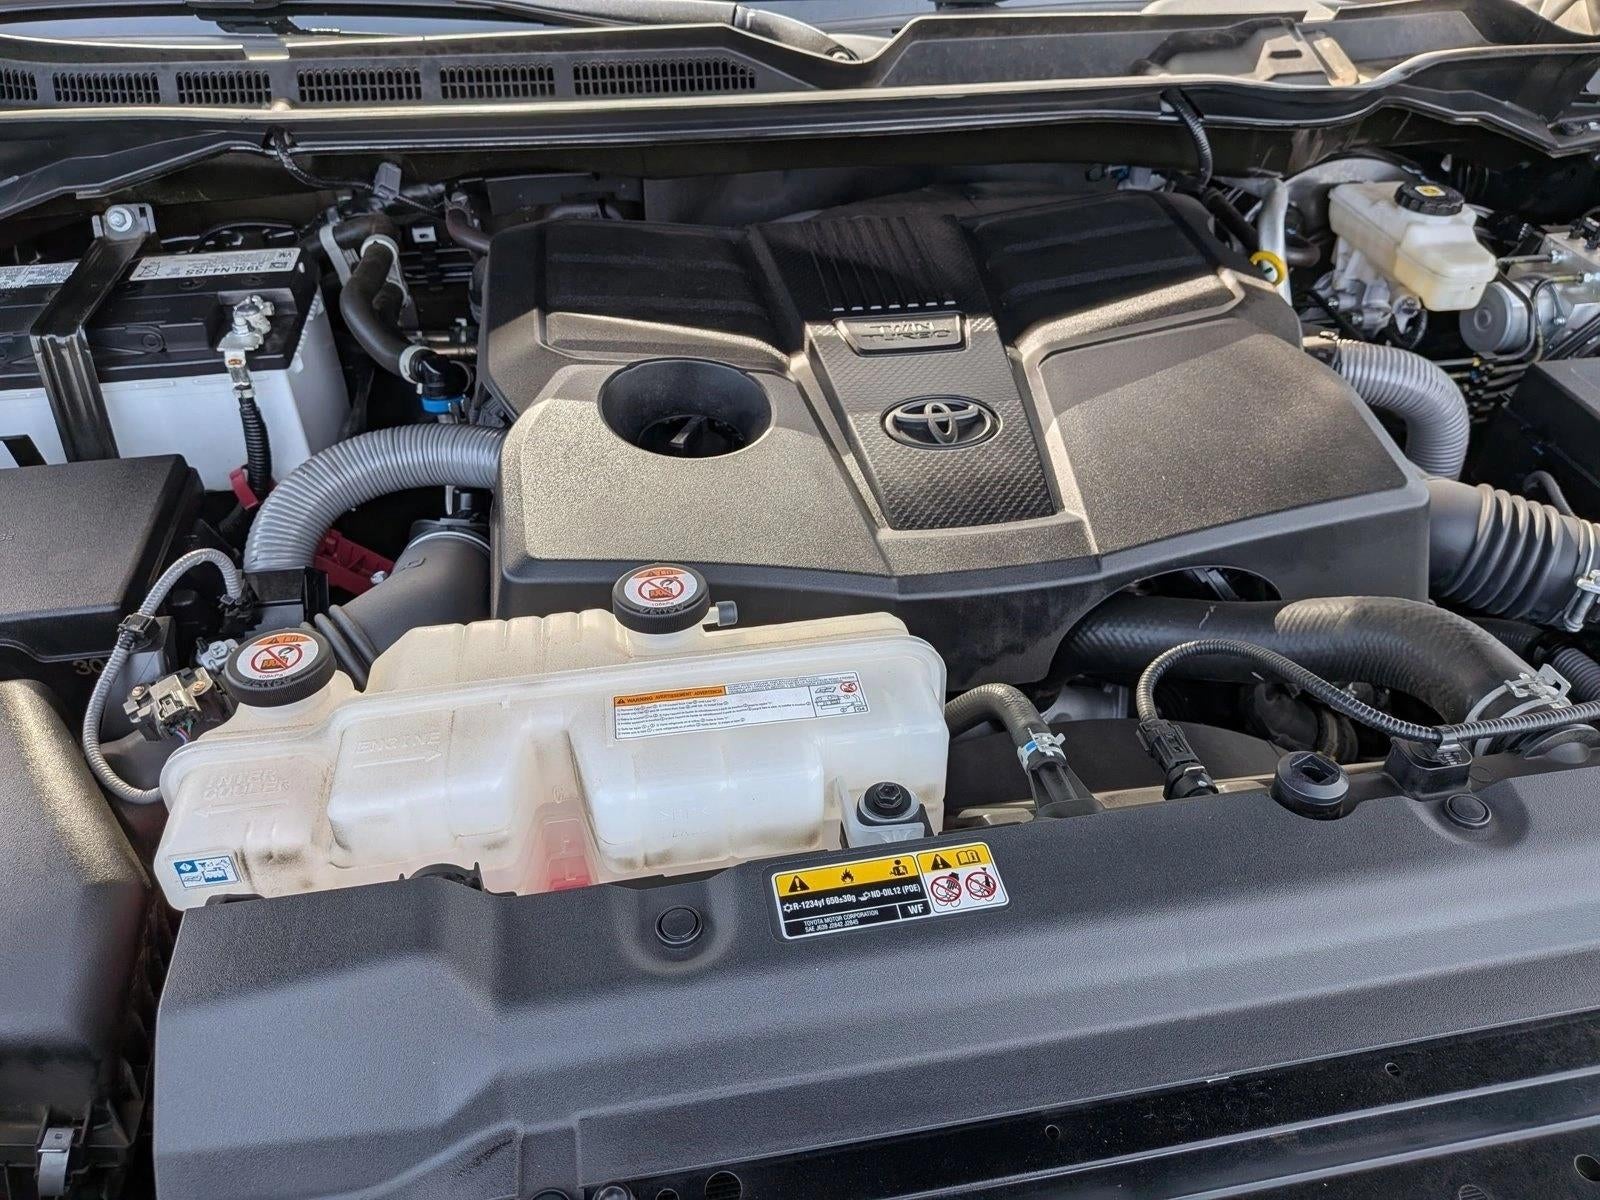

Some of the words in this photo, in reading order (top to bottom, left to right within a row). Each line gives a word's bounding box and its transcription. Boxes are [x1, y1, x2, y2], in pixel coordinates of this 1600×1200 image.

[792, 898, 825, 911] R-1234yf
[826, 893, 857, 905] 650±30g
[902, 883, 921, 895] (POE)
[907, 903, 924, 914] WF
[803, 919, 824, 927] TOYOTA
[824, 916, 842, 924] MOTOR
[843, 909, 879, 921] CORPORATION
[804, 925, 815, 933] SAE
